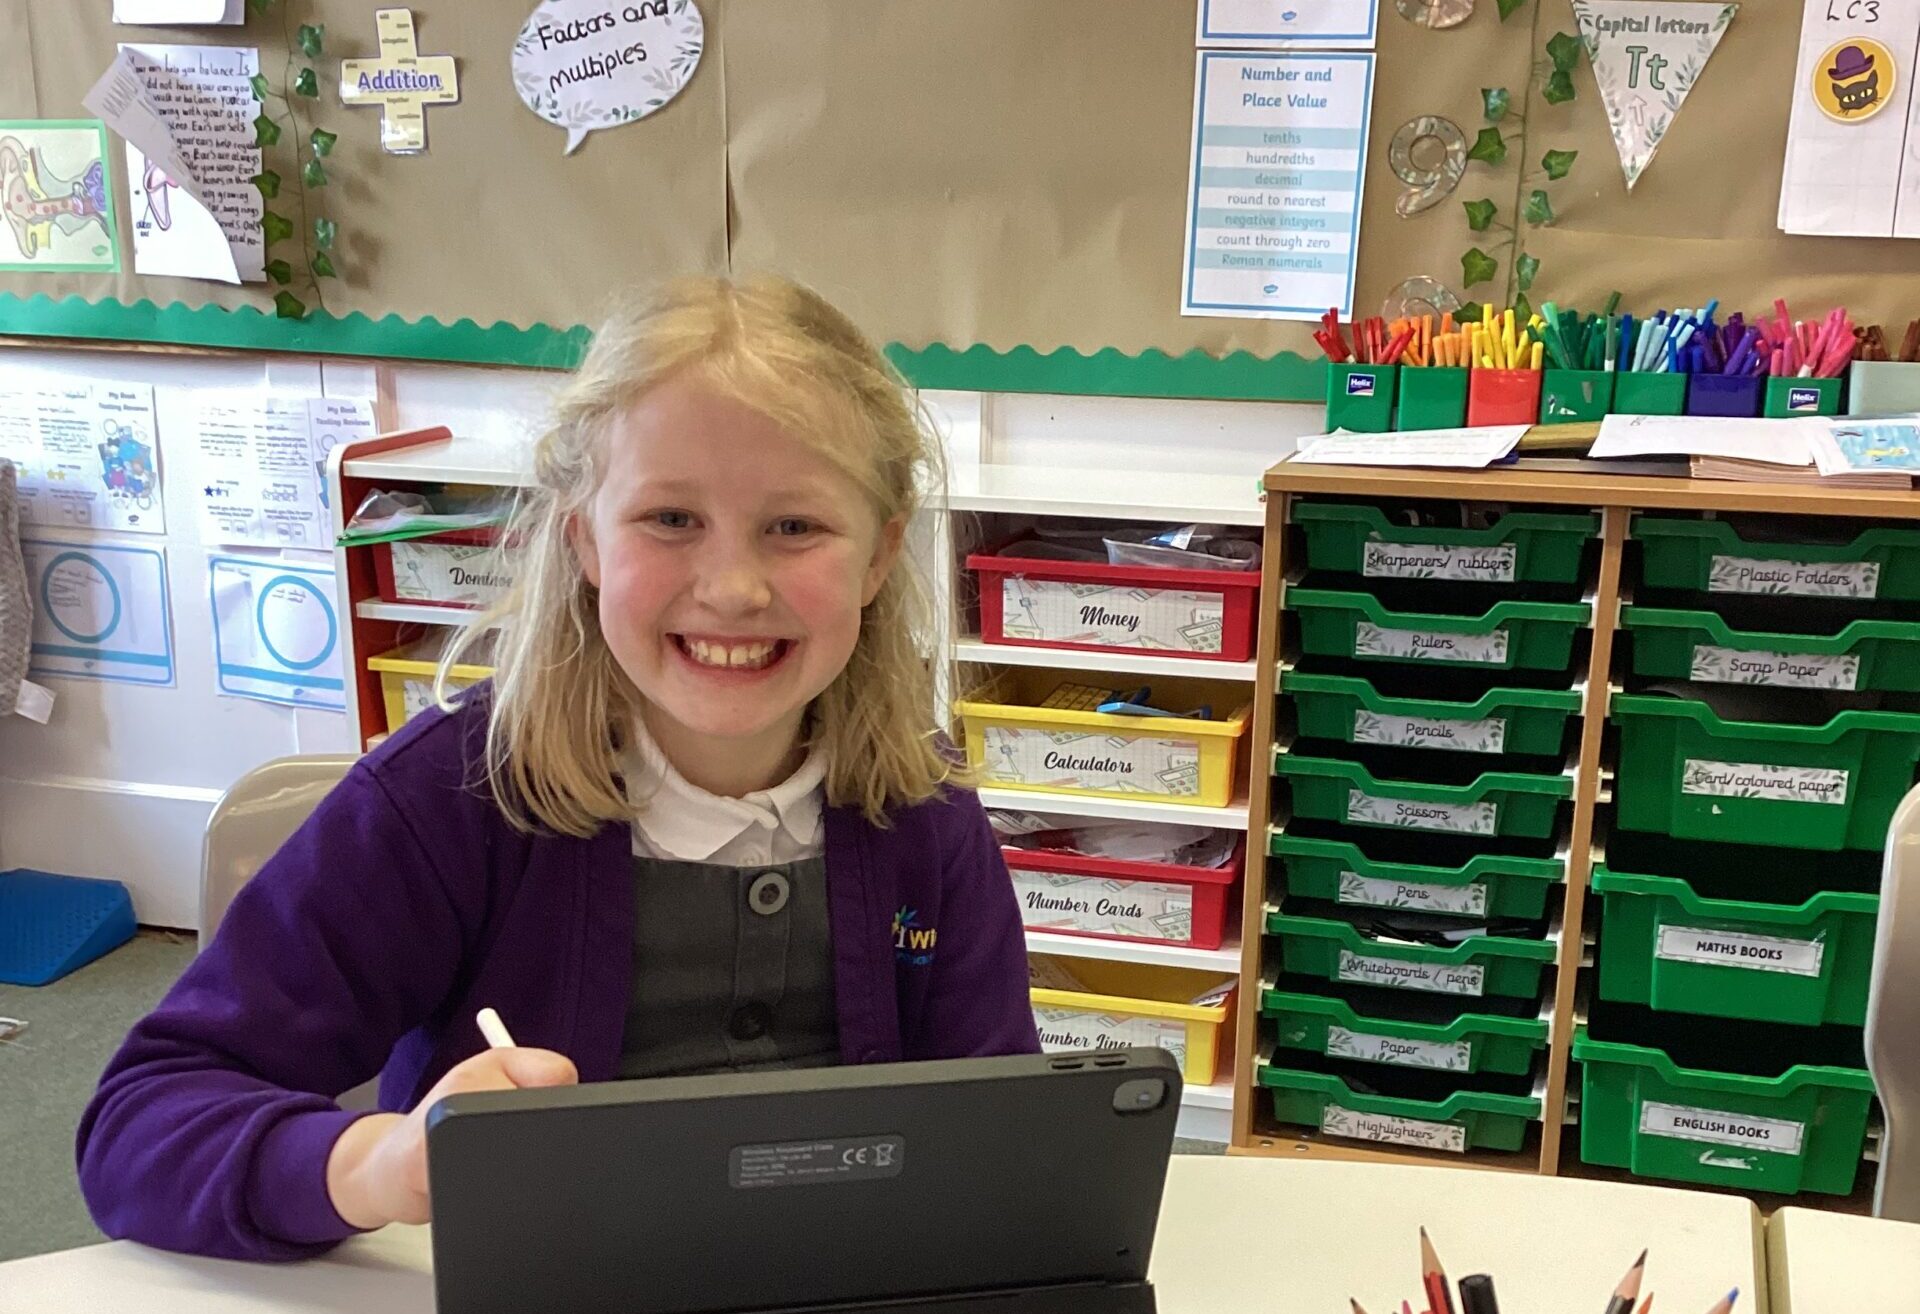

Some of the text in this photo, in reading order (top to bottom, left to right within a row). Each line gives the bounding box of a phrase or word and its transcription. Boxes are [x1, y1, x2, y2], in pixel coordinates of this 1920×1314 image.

[538, 0, 668, 50] Factors and
[1595, 15, 1709, 38] Capital letters
[550, 42, 647, 93] multiples
[1241, 67, 1332, 81] Number and
[1625, 46, 1668, 90] Tt
[358, 69, 442, 91] Addition
[1242, 93, 1327, 107] Place Value
[1263, 131, 1301, 144] tenths
[1246, 152, 1315, 165] hundredths
[1255, 173, 1303, 186] decimal
[1227, 193, 1326, 208] round to nearest
[1224, 215, 1326, 229] negative integers
[1217, 234, 1330, 249] count through zero
[1222, 254, 1322, 268] Roman numerals
[1793, 393, 1816, 401] Helix
[1368, 552, 1511, 571] Sharpeners/ rubbers
[1739, 567, 1852, 586] Plastic Folders
[1080, 605, 1140, 632] Money
[1412, 635, 1455, 649] Rulers
[1729, 658, 1823, 678] Scrap Paper
[1406, 723, 1454, 738] Pencils
[1044, 752, 1135, 773] Calculators
[1694, 769, 1839, 795] Card/coloured paper
[1396, 804, 1450, 820] Scissors
[1397, 886, 1430, 899] Pens
[1026, 892, 1143, 918] Number Cards
[1696, 940, 1783, 960] MATHS BOOKS
[1346, 959, 1430, 979] Whiteboards
[1446, 973, 1478, 987] pens
[1380, 1040, 1420, 1055] Paper
[1356, 1120, 1435, 1140] Highlighters
[1673, 1116, 1770, 1139] ENGLISH BOOKS
